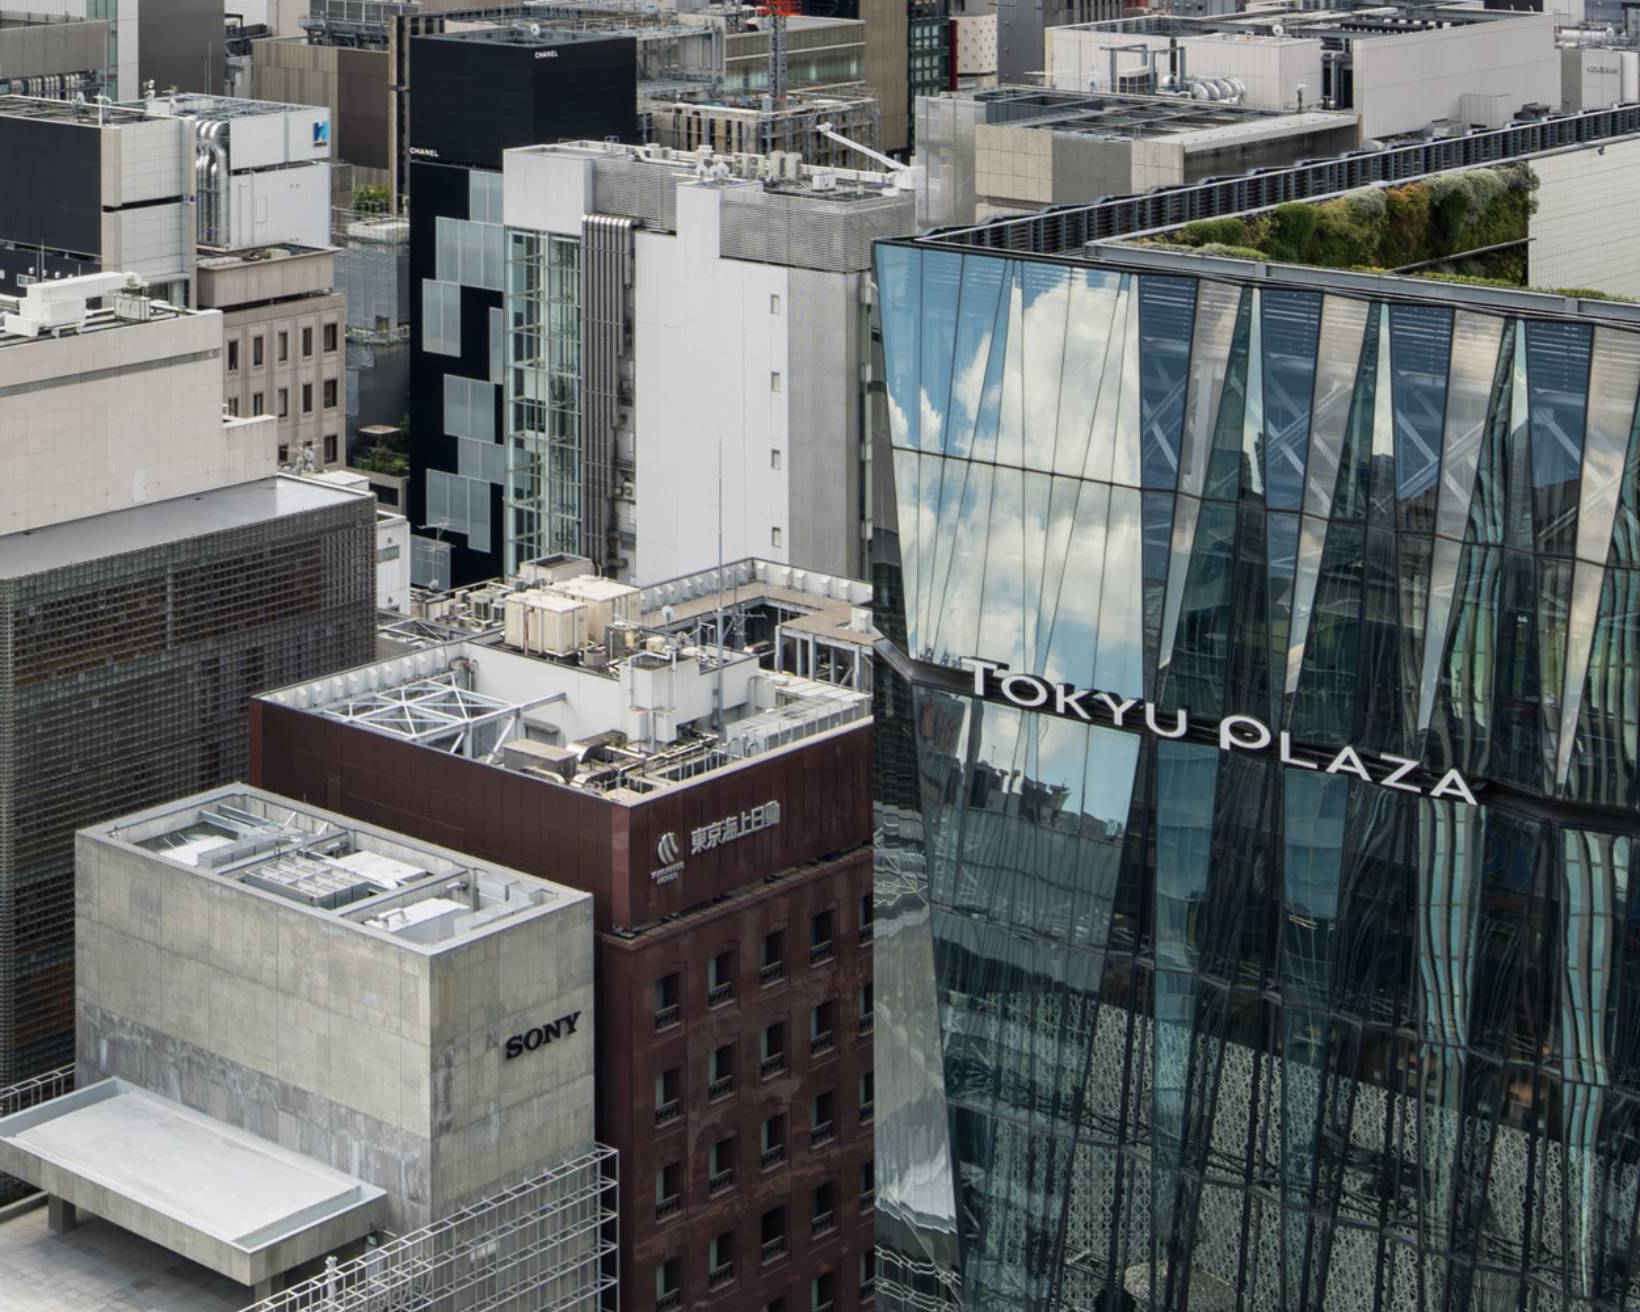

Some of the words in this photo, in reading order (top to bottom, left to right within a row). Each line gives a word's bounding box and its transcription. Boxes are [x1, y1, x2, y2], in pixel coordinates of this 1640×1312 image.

[961, 656, 1188, 738] TOKYU
[1219, 715, 1479, 806] PLAZA
[505, 1010, 582, 1061] SONY
